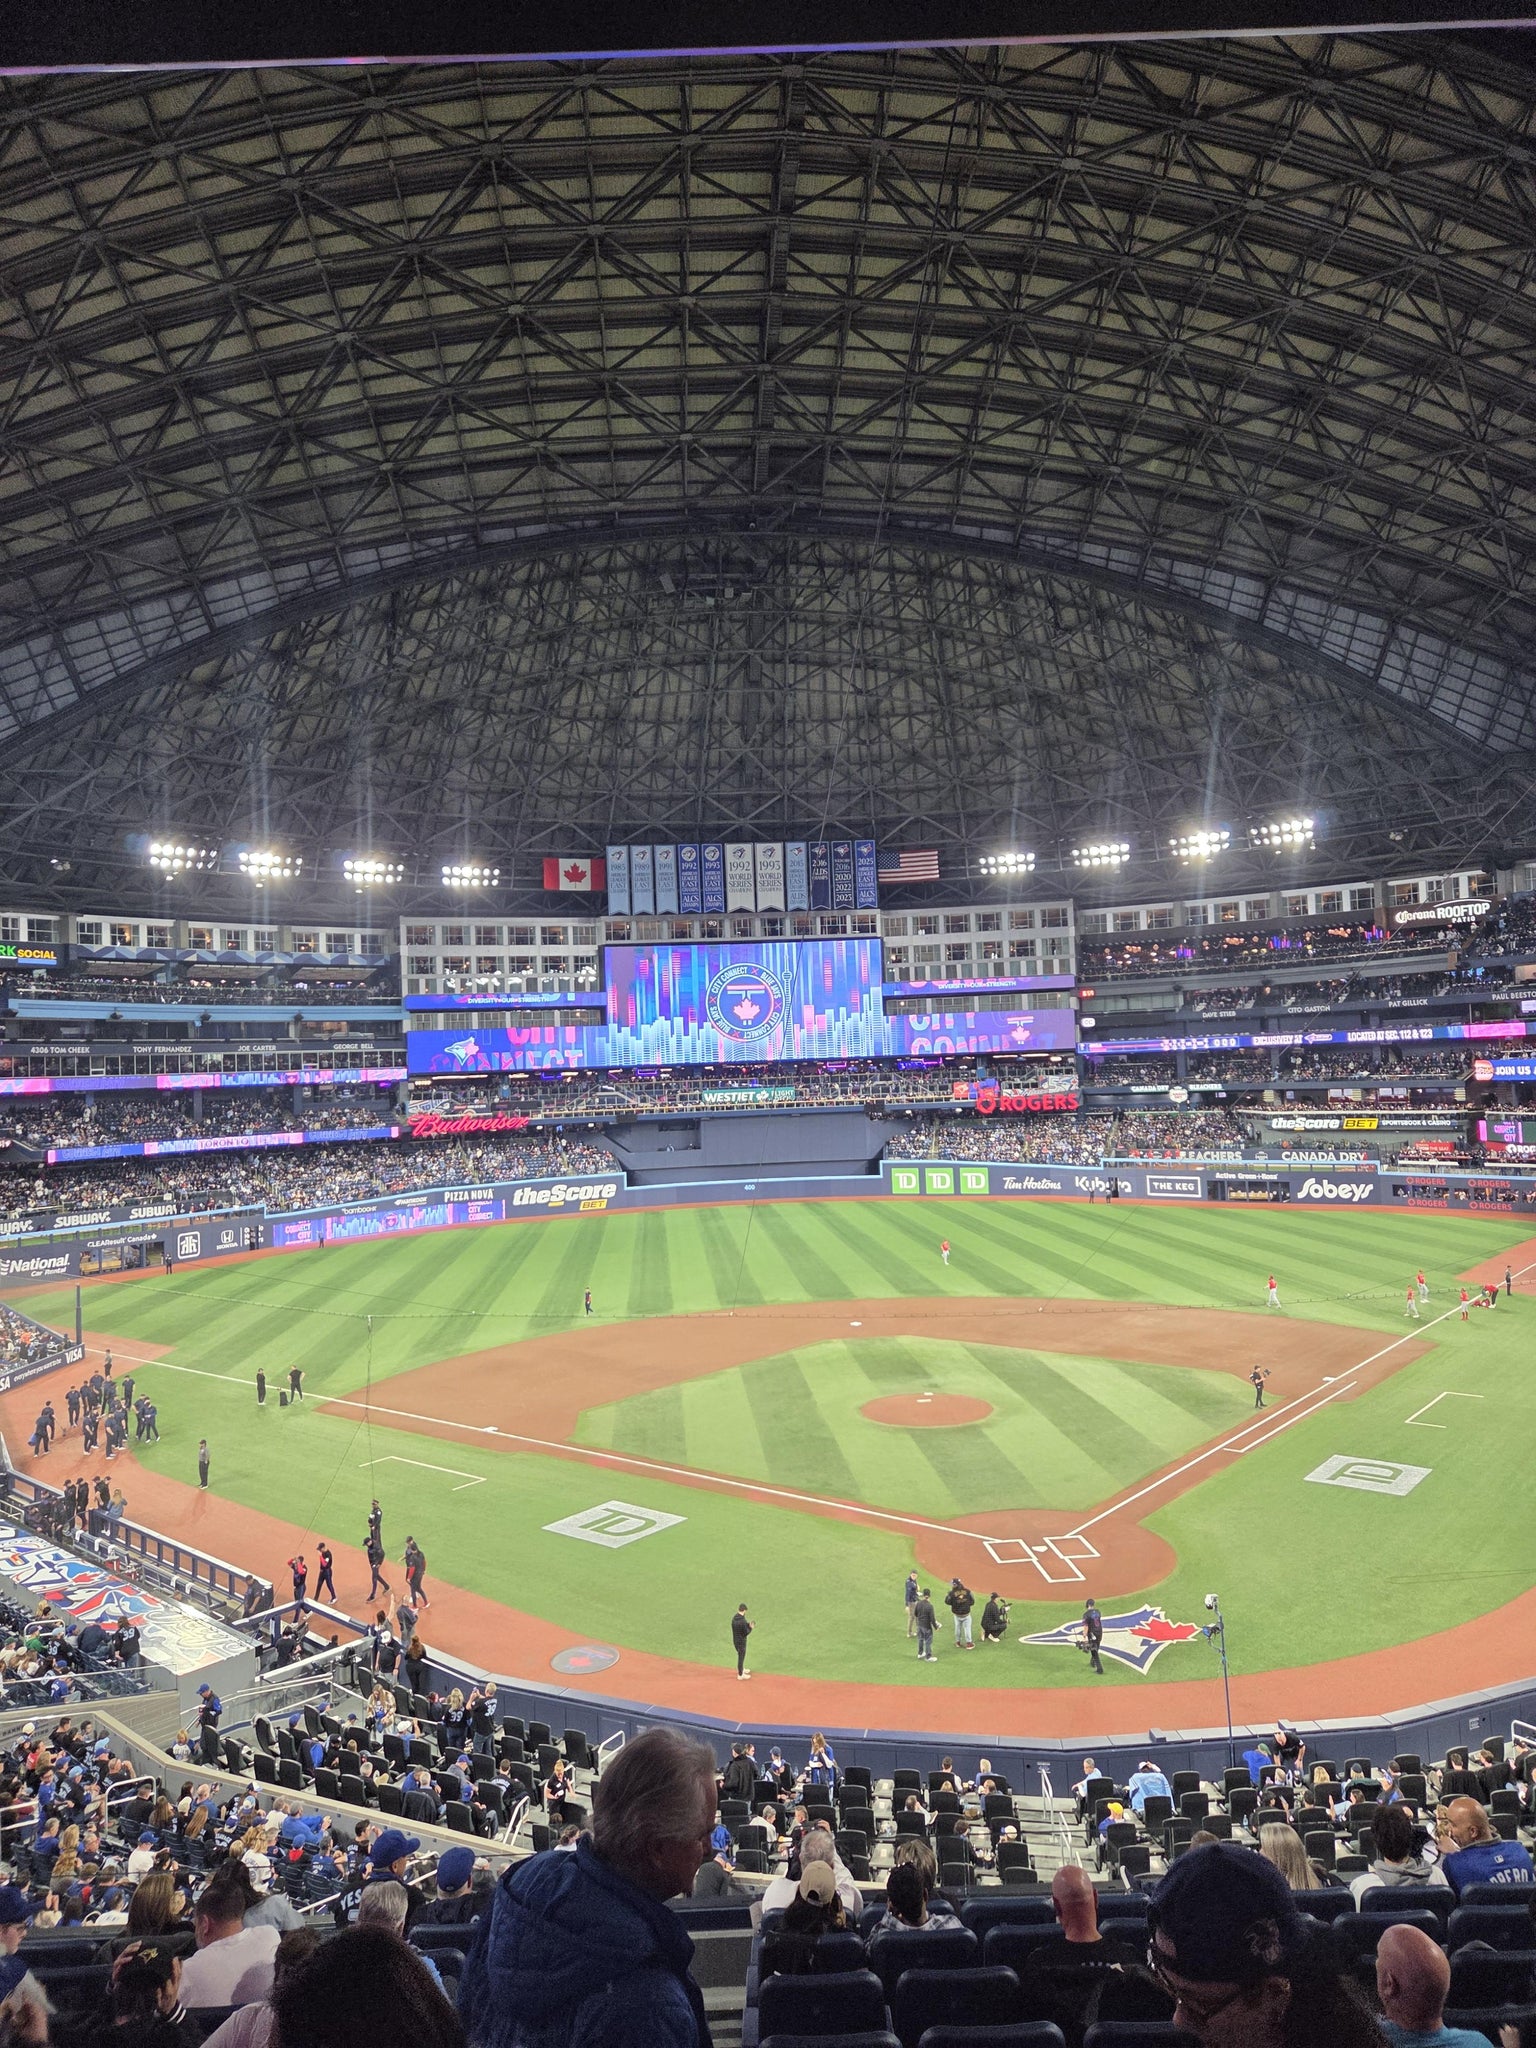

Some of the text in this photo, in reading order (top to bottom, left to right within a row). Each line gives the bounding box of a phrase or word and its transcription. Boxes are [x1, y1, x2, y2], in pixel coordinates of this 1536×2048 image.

[729, 862, 750, 871] 1992
[760, 861, 781, 870] 1993
[1395, 903, 1491, 923] Corona ROOFTOP
[18, 949, 56, 960] SOCIAL
[712, 967, 748, 994] CITY CONNECT
[760, 972, 774, 985] BLUE
[744, 1012, 780, 1038] CITY CONNECT
[1253, 1036, 1292, 1045] EXCLUSIVELY
[1348, 1029, 1432, 1041] LOCATED AT SEC. 112 & 123
[1496, 1066, 1515, 1075] JOIN
[1517, 1066, 1531, 1074] US
[704, 1092, 756, 1102] WESTJET
[1000, 1094, 1079, 1111] ROGERS
[408, 1111, 529, 1136] Budweiser
[1272, 1117, 1340, 1129] theScore
[200, 1138, 249, 1148] TORONTO
[1504, 1134, 1516, 1142] CITY
[1282, 1152, 1366, 1161] CANADA DRY
[895, 1173, 916, 1189] TD
[928, 1173, 950, 1189] TD
[962, 1173, 985, 1189] TD
[1002, 1176, 1061, 1190] Tim Hortons
[1153, 1182, 1172, 1190] THE
[1415, 1177, 1446, 1185] ROGERS
[1477, 1179, 1510, 1188] ROGERS
[444, 1188, 494, 1202] PIZZA NOVA
[513, 1183, 616, 1206] theScore
[1298, 1178, 1374, 1202] Sobeys
[1479, 1202, 1512, 1210] ROGERS
[54, 1212, 111, 1228] SUBWAY
[128, 1234, 151, 1243] Canada
[10, 1254, 70, 1274] National
[44, 1267, 67, 1275] Rental
[65, 1348, 82, 1364] VISA
[1326, 1462, 1403, 1484] TD
[578, 1508, 657, 1536] TD
[122, 1627, 134, 1641] 39
[450, 1712, 463, 1722] 39
[340, 1888, 362, 1910] YES
